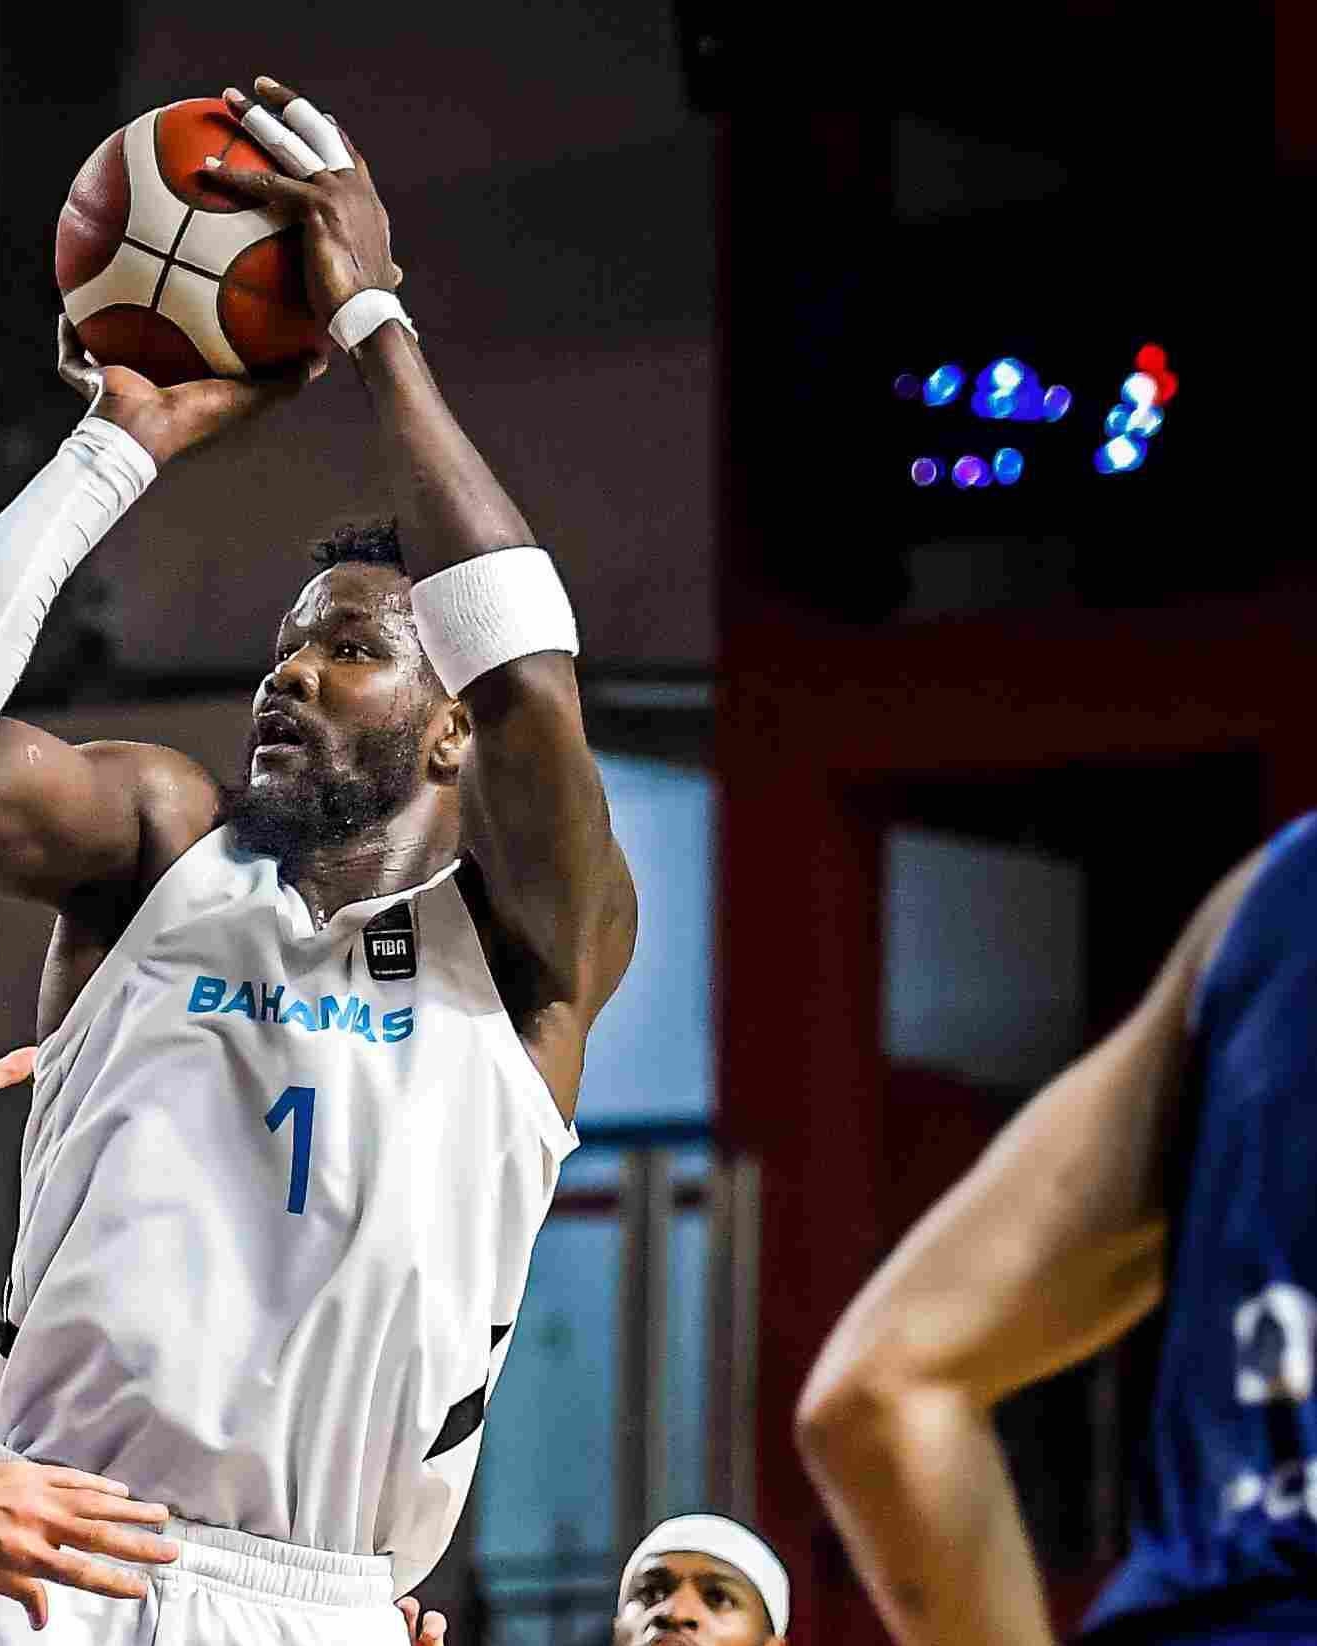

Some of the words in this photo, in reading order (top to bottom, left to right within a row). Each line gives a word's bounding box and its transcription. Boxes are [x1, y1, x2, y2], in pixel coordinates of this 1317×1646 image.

[372, 939, 407, 956] FIBA
[186, 975, 415, 1043] BAHAMAS
[264, 1085, 315, 1215] 1
